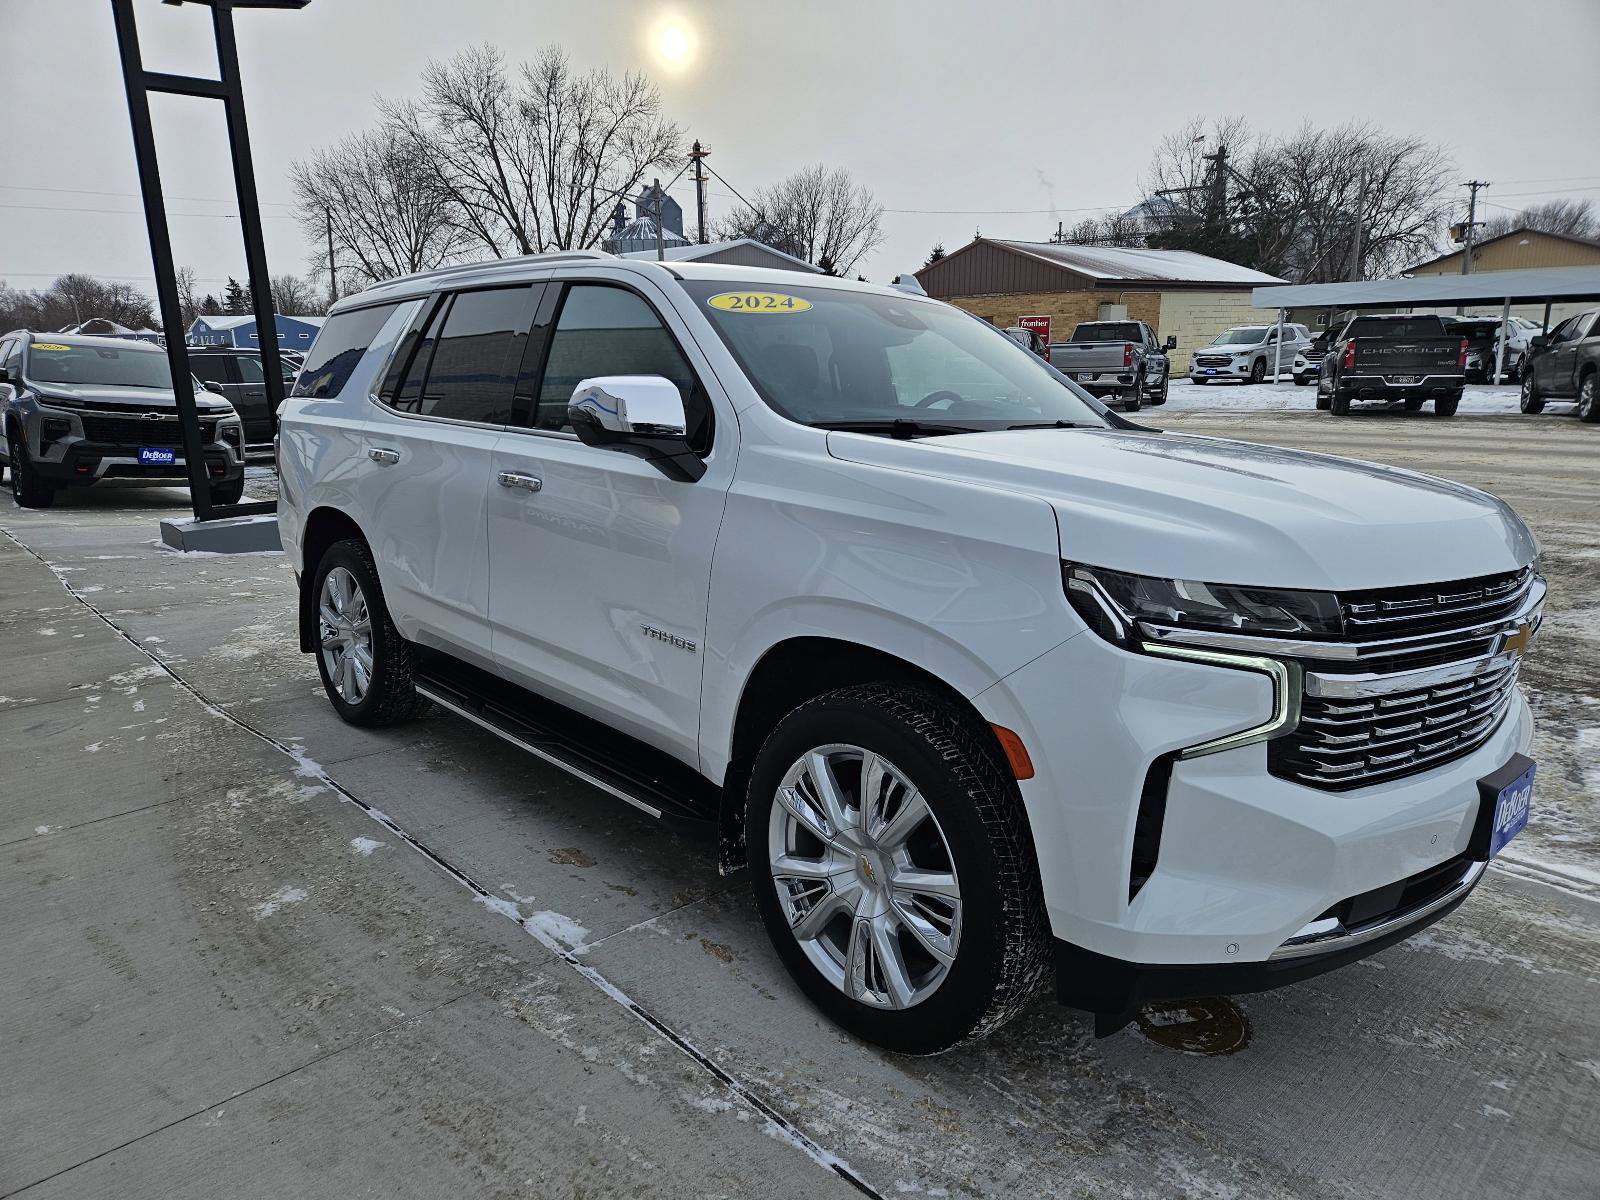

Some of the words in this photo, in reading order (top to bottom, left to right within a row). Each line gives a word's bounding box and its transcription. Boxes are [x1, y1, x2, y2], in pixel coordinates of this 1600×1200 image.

[728, 295, 795, 309] 2024
[1020, 318, 1048, 328] frontier
[1362, 347, 1454, 355] CHEVROLET
[640, 623, 697, 653] TAHOE
